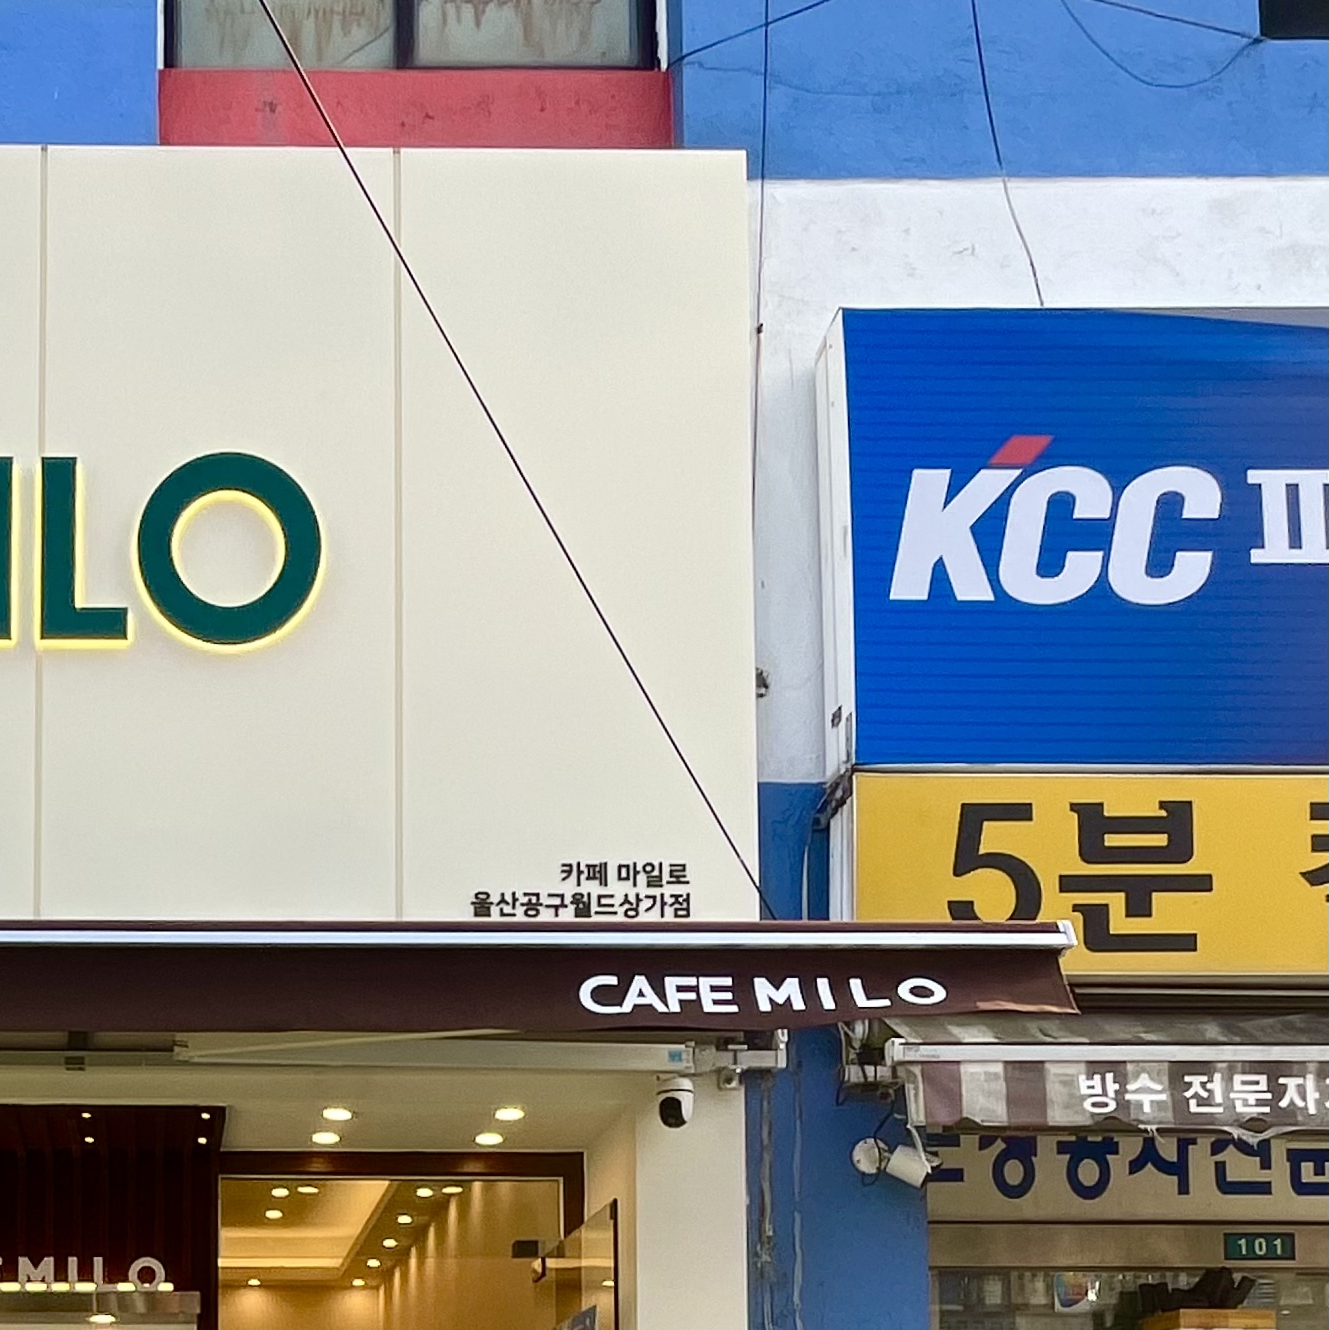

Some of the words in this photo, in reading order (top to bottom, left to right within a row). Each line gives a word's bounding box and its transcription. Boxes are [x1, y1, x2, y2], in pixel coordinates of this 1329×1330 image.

[889, 450, 1223, 606] KCC
[560, 861, 609, 888] 카페
[617, 861, 691, 889] 마일로
[947, 800, 1213, 953] 5분
[470, 891, 692, 918] 울산공구월드상가점
[578, 974, 740, 1014] CAFE
[753, 976, 948, 1013] MILO
[1079, 1073, 1167, 1114] 방수
[1183, 1073, 1329, 1115] 전문자
[1237, 1237, 1283, 1257] 101
[18, 1256, 165, 1292] MILO
